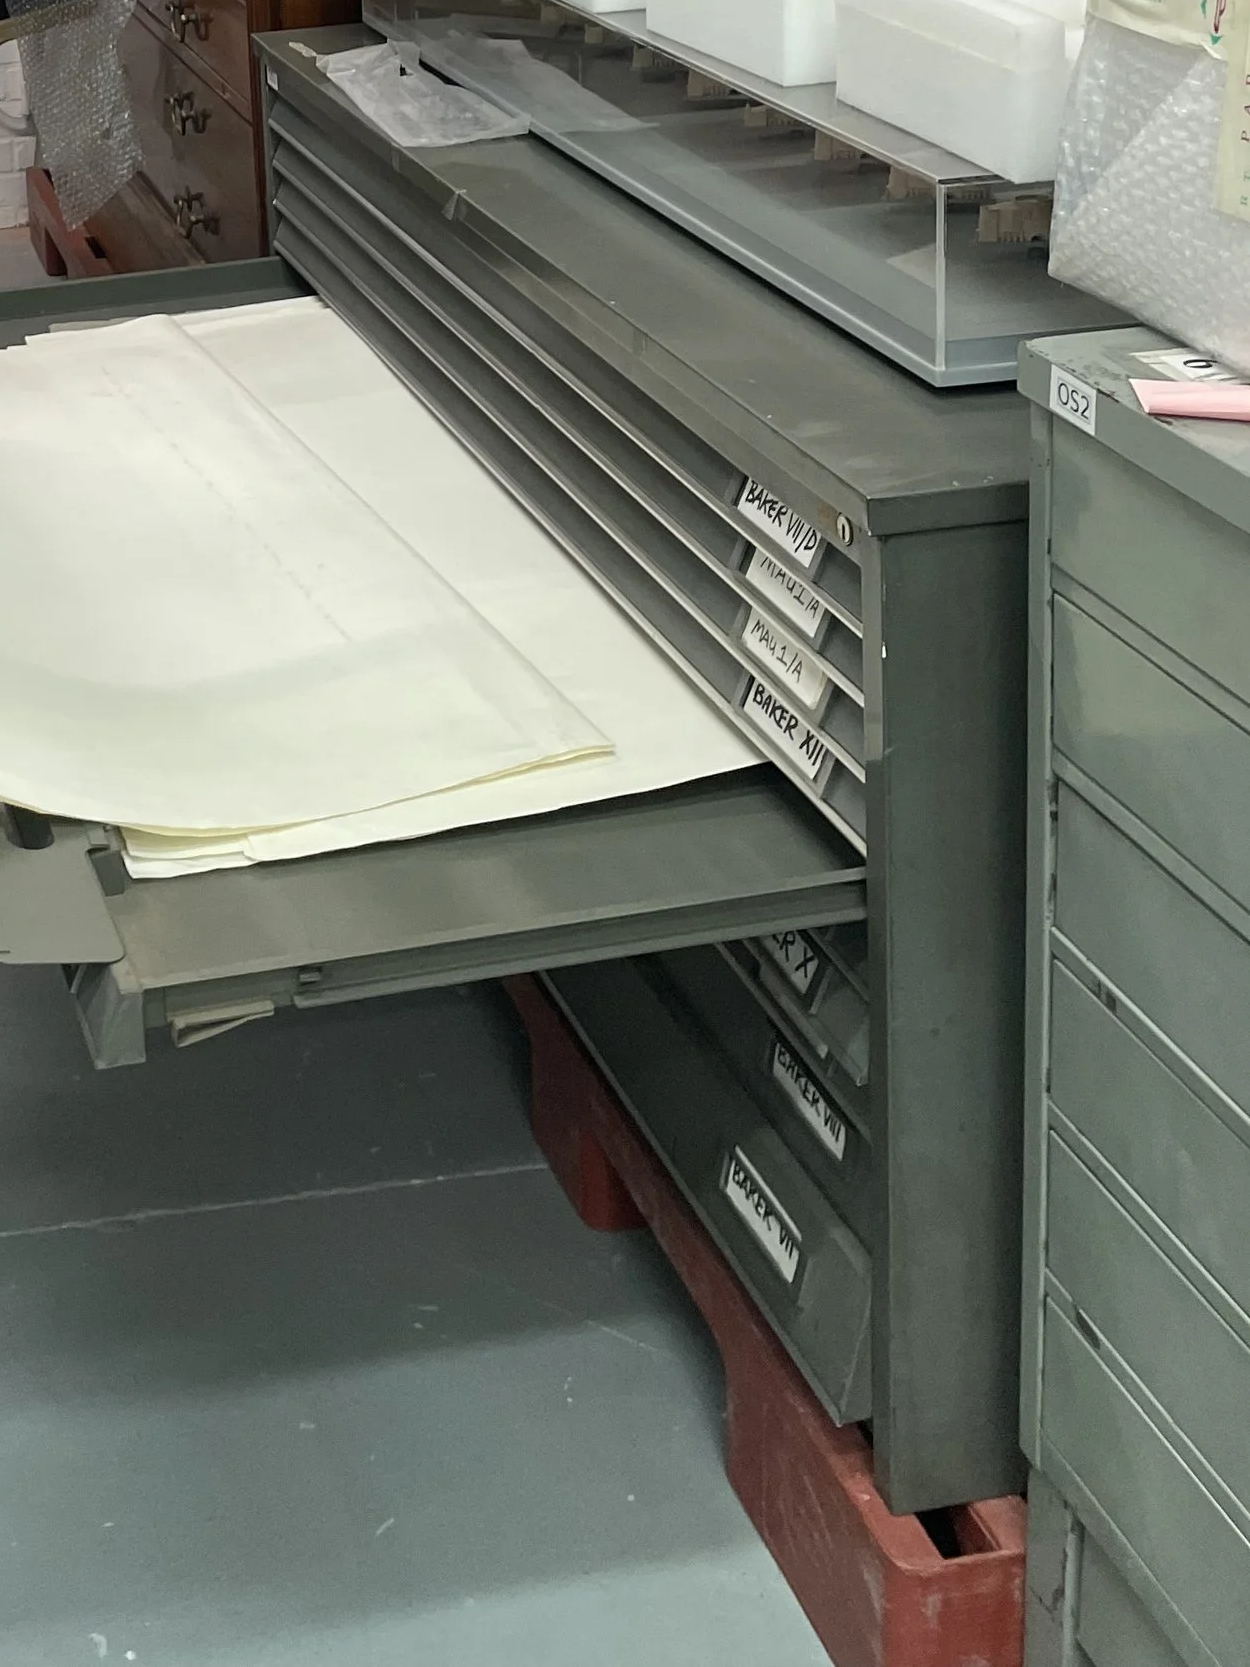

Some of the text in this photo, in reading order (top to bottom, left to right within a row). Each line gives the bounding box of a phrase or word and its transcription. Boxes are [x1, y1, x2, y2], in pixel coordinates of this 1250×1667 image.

[1058, 382, 1090, 420] OS2
[745, 479, 788, 528] BAKER
[776, 645, 803, 684] 1/A
[752, 683, 799, 741] BAKER
